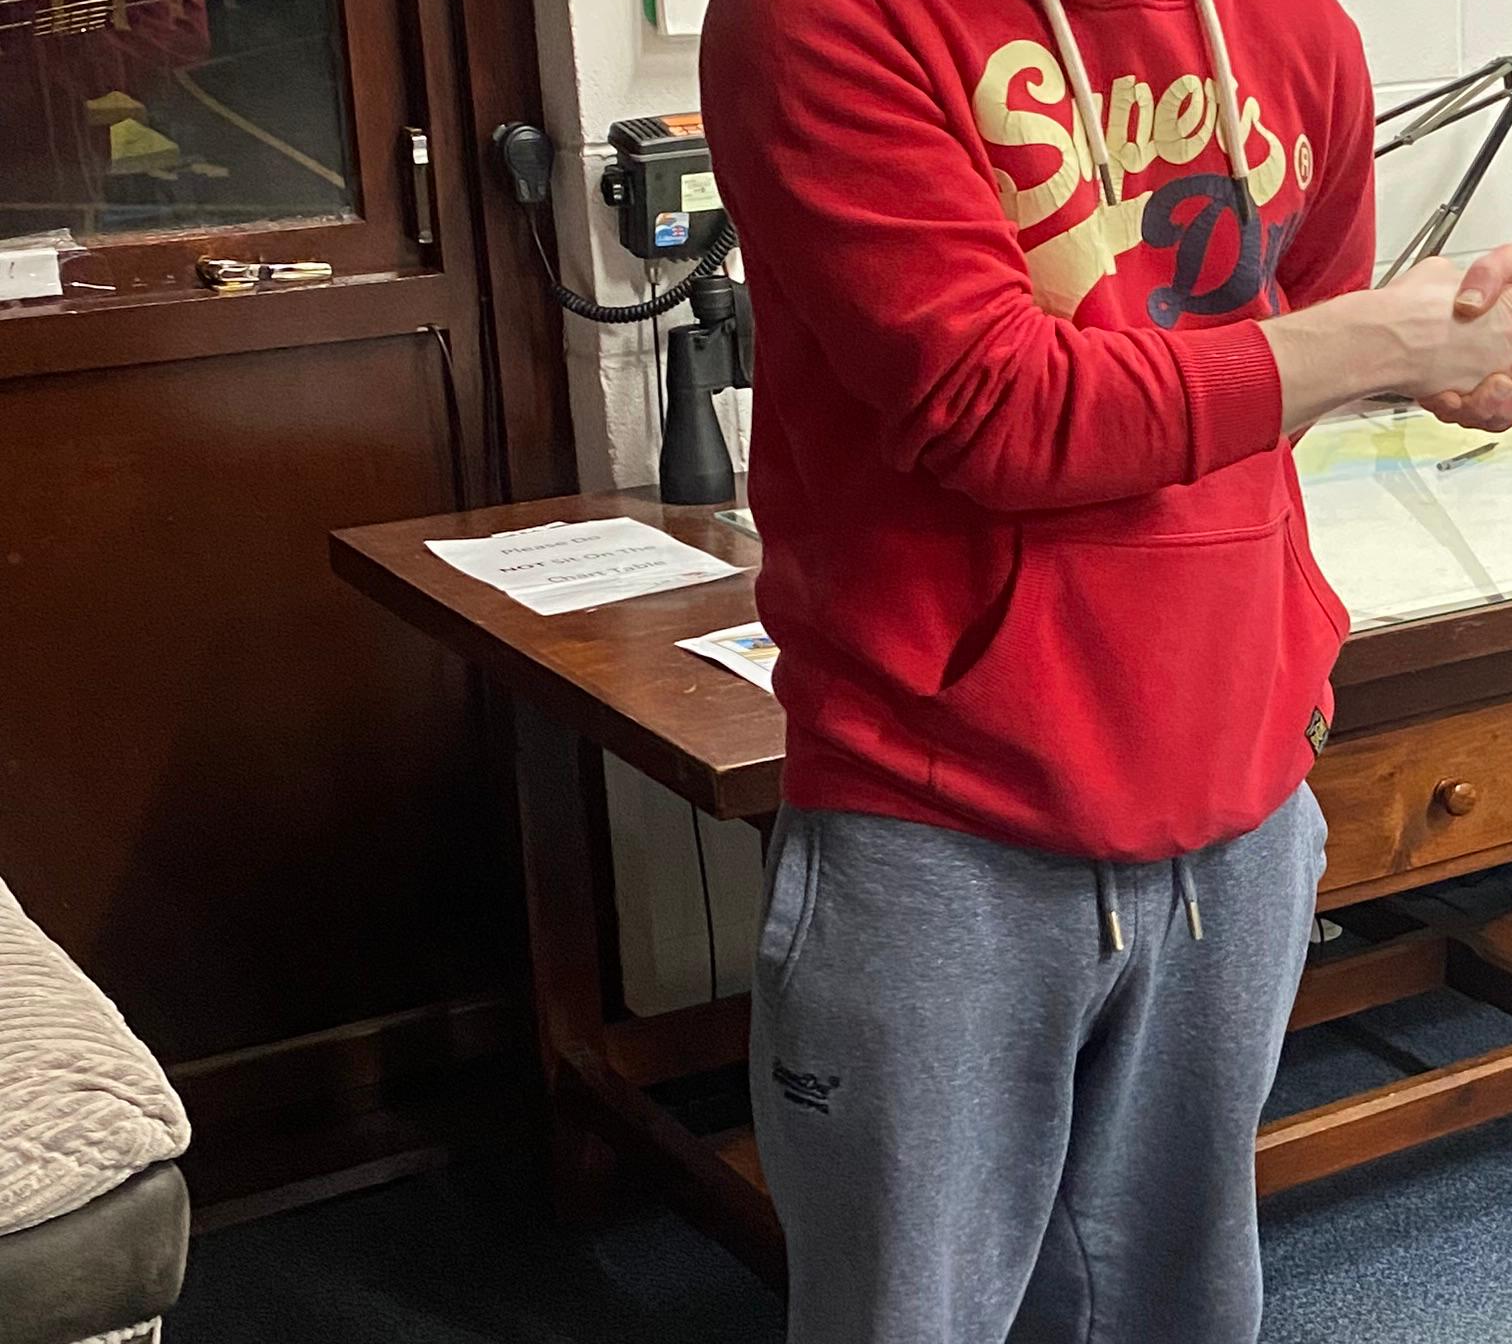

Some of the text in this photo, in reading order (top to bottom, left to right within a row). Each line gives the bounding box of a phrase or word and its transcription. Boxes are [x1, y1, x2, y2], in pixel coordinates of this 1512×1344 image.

[501, 534, 601, 556] Please Do
[499, 543, 657, 574] NOT Sit On The
[548, 558, 667, 584] Chart Table
